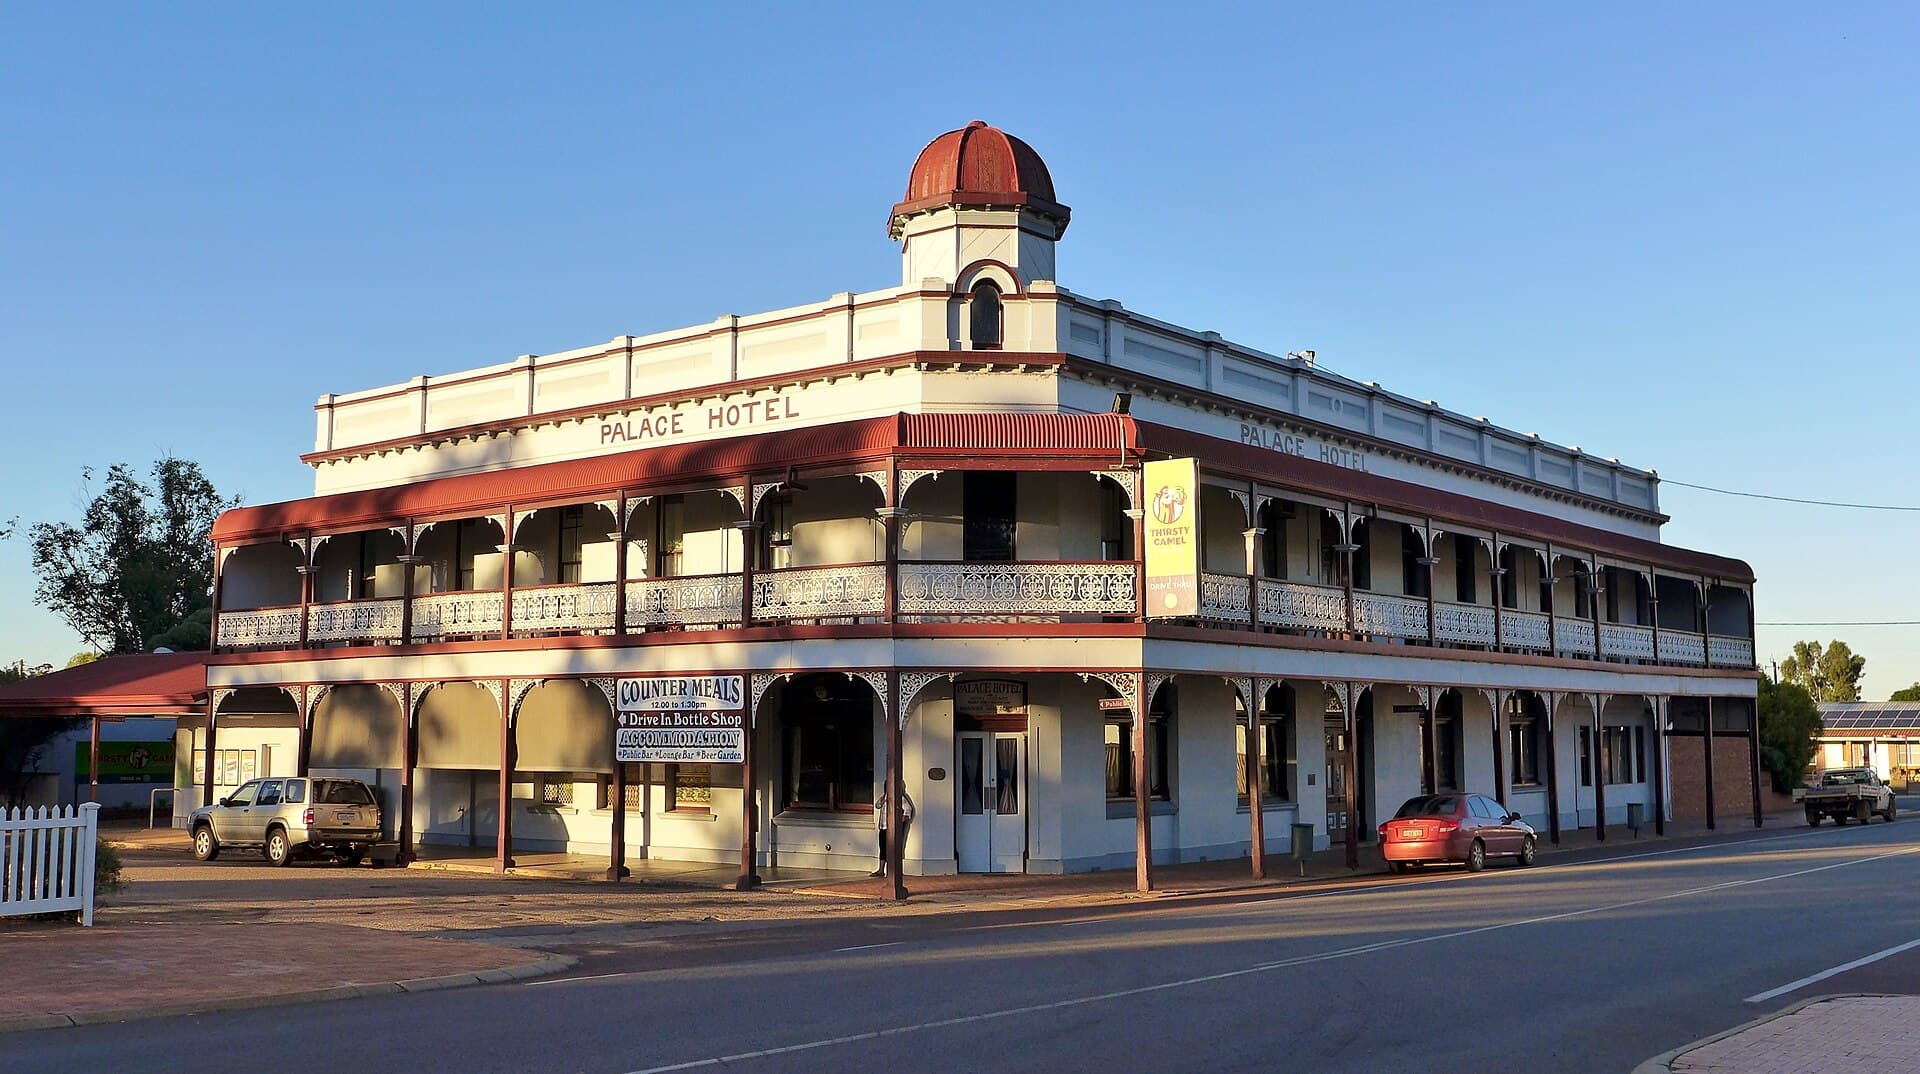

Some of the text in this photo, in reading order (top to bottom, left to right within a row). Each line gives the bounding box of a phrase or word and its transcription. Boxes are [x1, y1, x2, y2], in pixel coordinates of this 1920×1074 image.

[600, 396, 799, 444] PALACE HOTEL
[1240, 423, 1368, 473] PALACE HOTEL
[1150, 526, 1190, 537] THIRSTY
[1153, 537, 1187, 546] CAMEL
[621, 677, 740, 705] COUNTER MEALS
[957, 681, 1022, 693] PALACE HOTEL
[671, 701, 679, 709] to
[629, 711, 742, 727] Drive In Bottle Shop
[619, 730, 740, 748] ACCOMMODATION
[717, 750, 742, 760] Garden
